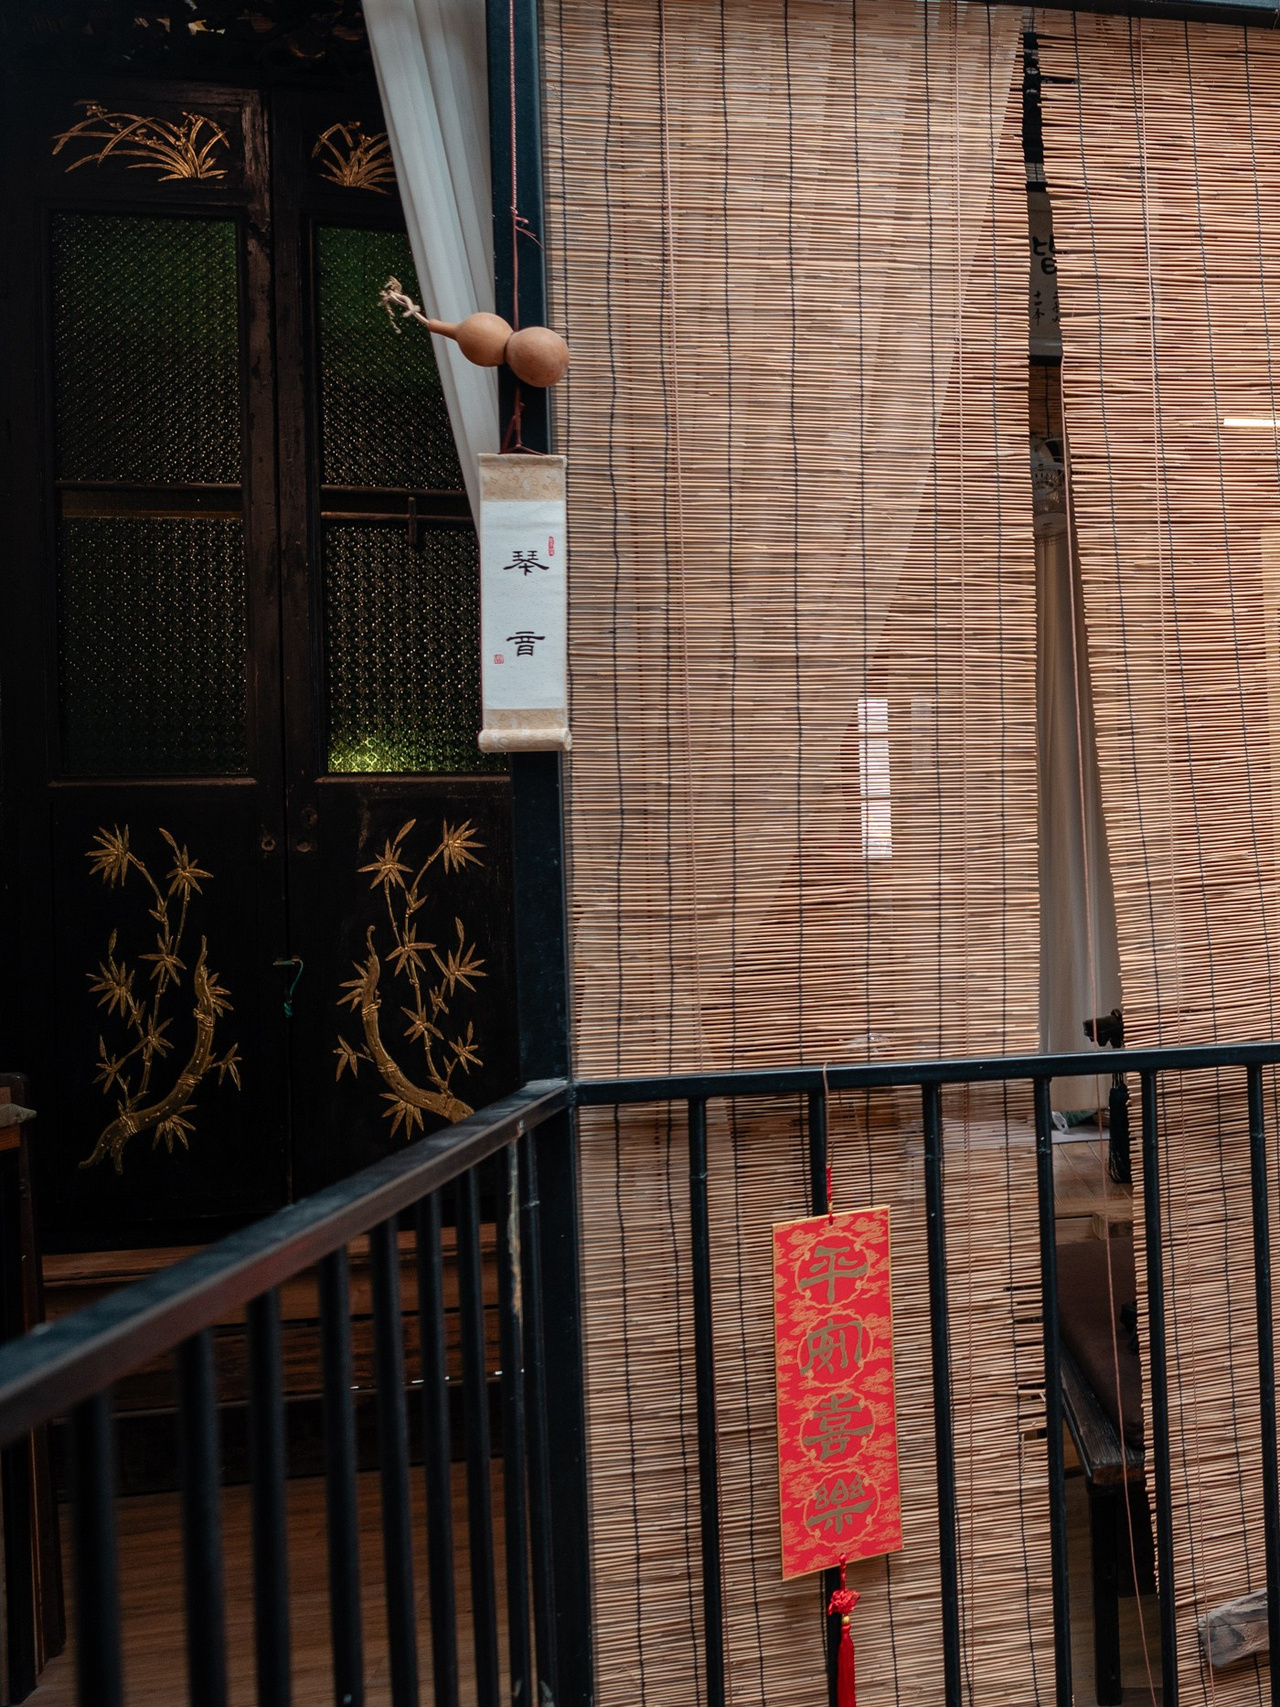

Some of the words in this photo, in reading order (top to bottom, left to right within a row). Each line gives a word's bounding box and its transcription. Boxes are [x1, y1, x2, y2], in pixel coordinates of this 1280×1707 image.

[503, 550, 550, 657] 琴音
[799, 1245, 876, 1536] 平安喜樂
